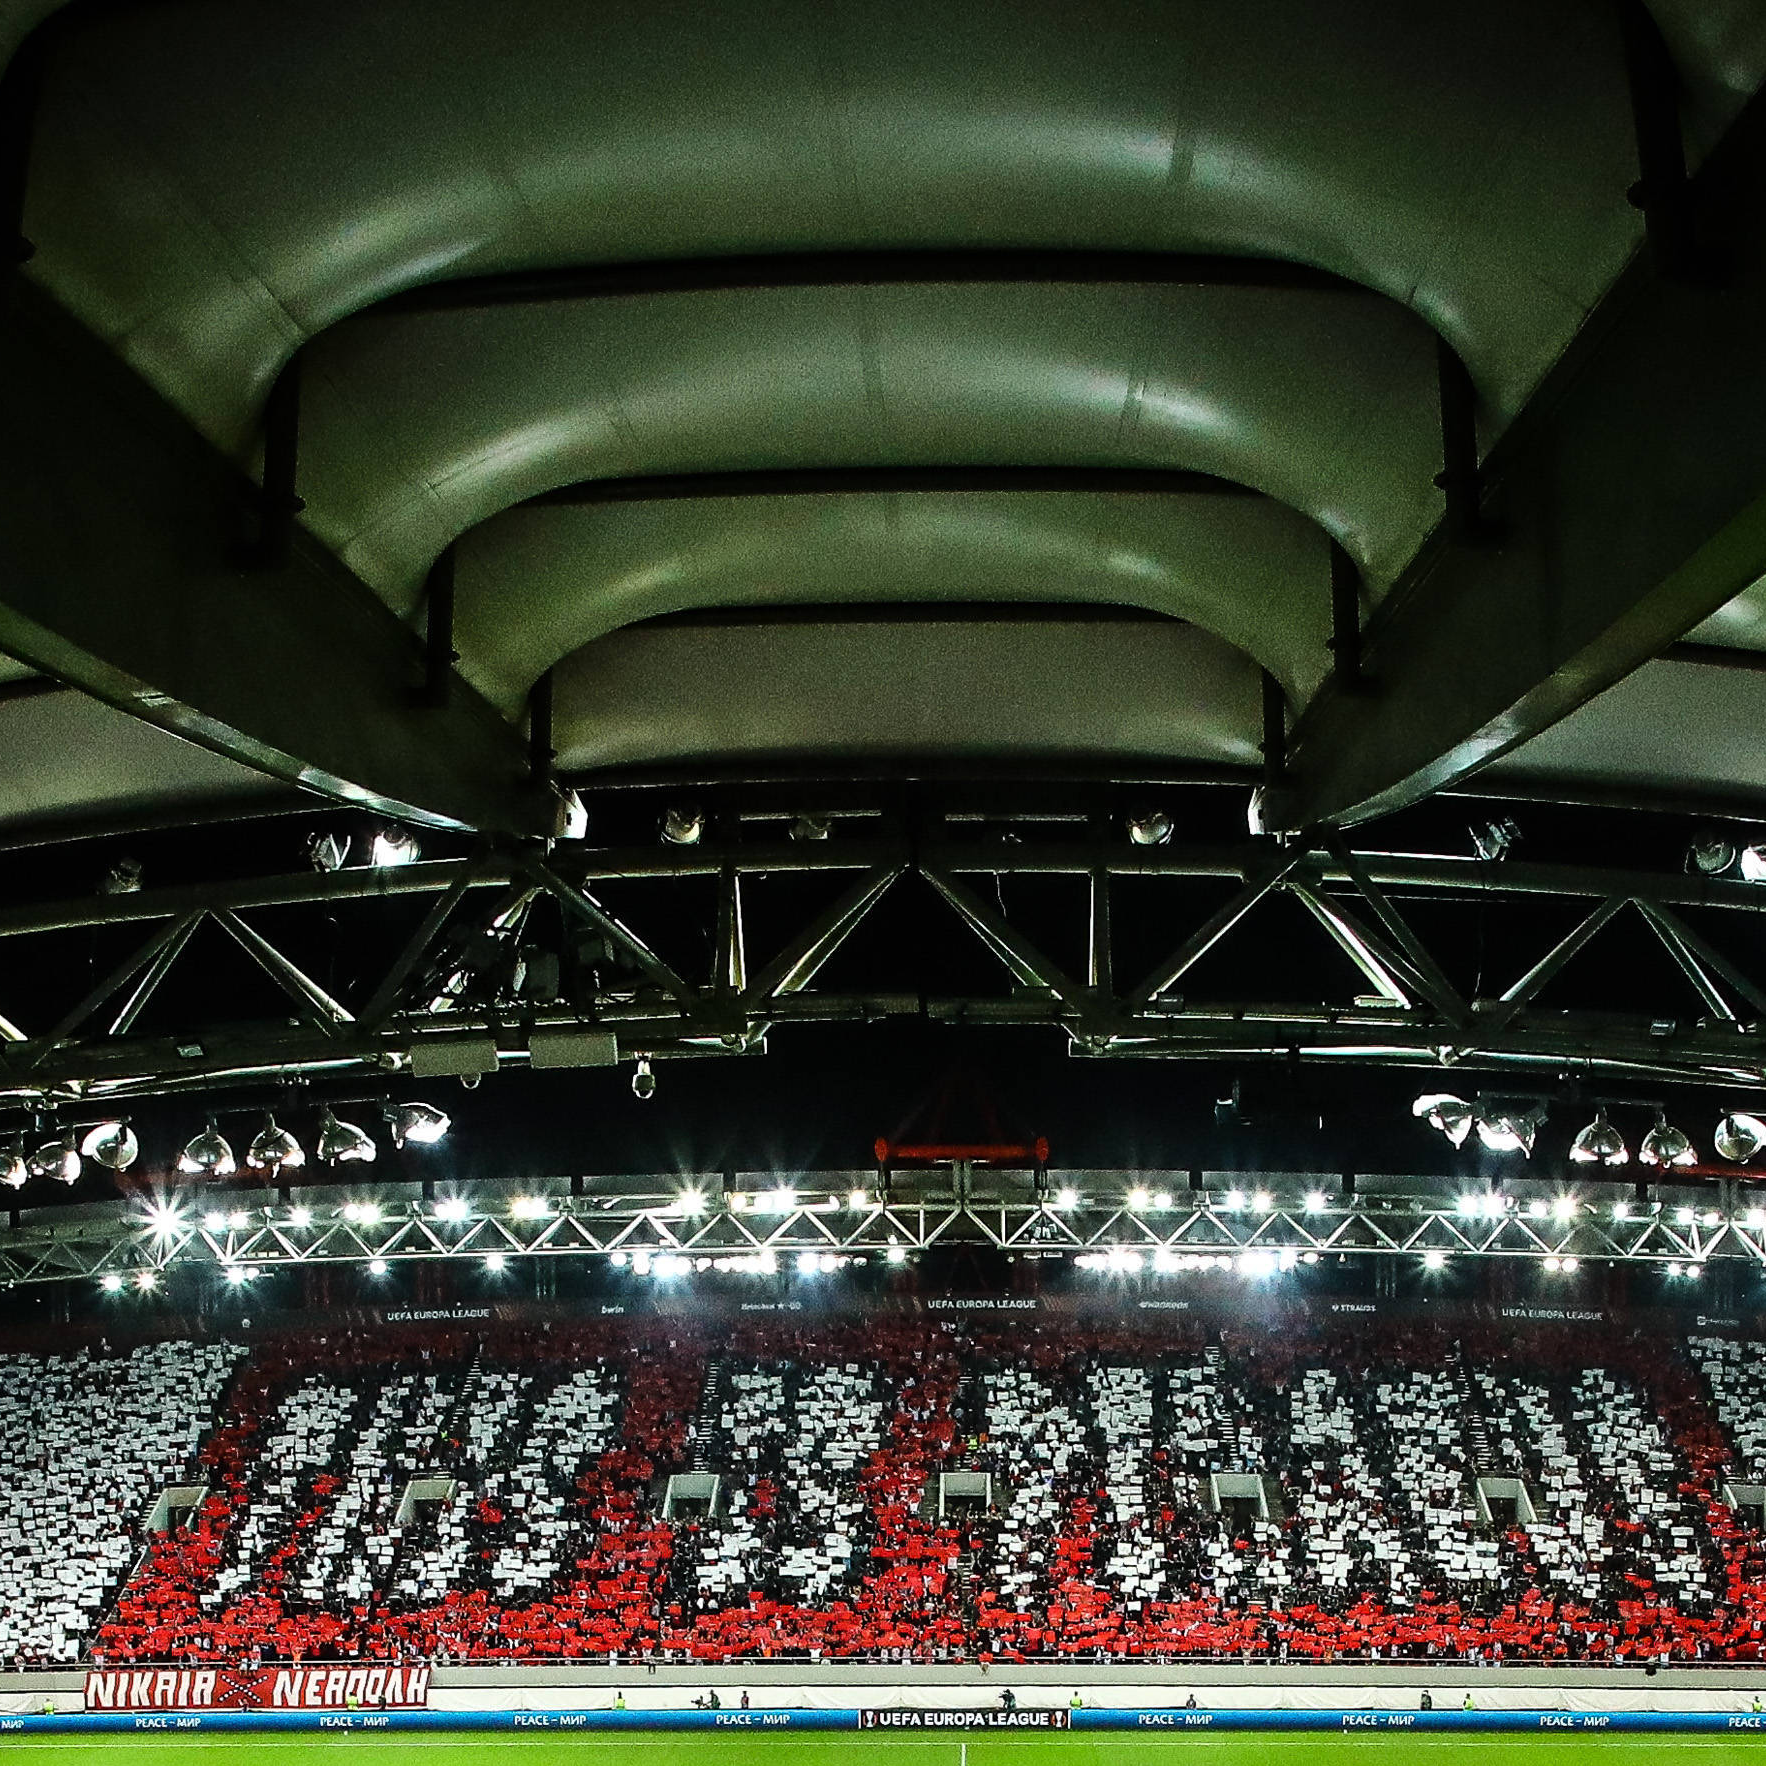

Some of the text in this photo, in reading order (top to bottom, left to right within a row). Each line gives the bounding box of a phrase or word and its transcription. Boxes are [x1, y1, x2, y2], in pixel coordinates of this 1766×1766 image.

[928, 1300, 1037, 1309] UEFA EUROPA LEAGUE
[387, 1308, 490, 1321] UEFA EUROPA LEAGUE
[1502, 1308, 1526, 1318] UEFA
[1528, 1309, 1565, 1320] EUROPA
[135, 1718, 167, 1729] PEACE
[319, 1716, 352, 1728] PEACE
[514, 1715, 548, 1726] PEACE
[715, 1714, 752, 1726] PEACE
[879, 1712, 1050, 1726] UEFA EUROPA LEAGUE
[1138, 1714, 1174, 1726] PEACE
[1341, 1714, 1377, 1726] PEACE
[1539, 1715, 1573, 1726] PEACE
[1728, 1717, 1761, 1728] PEACE
